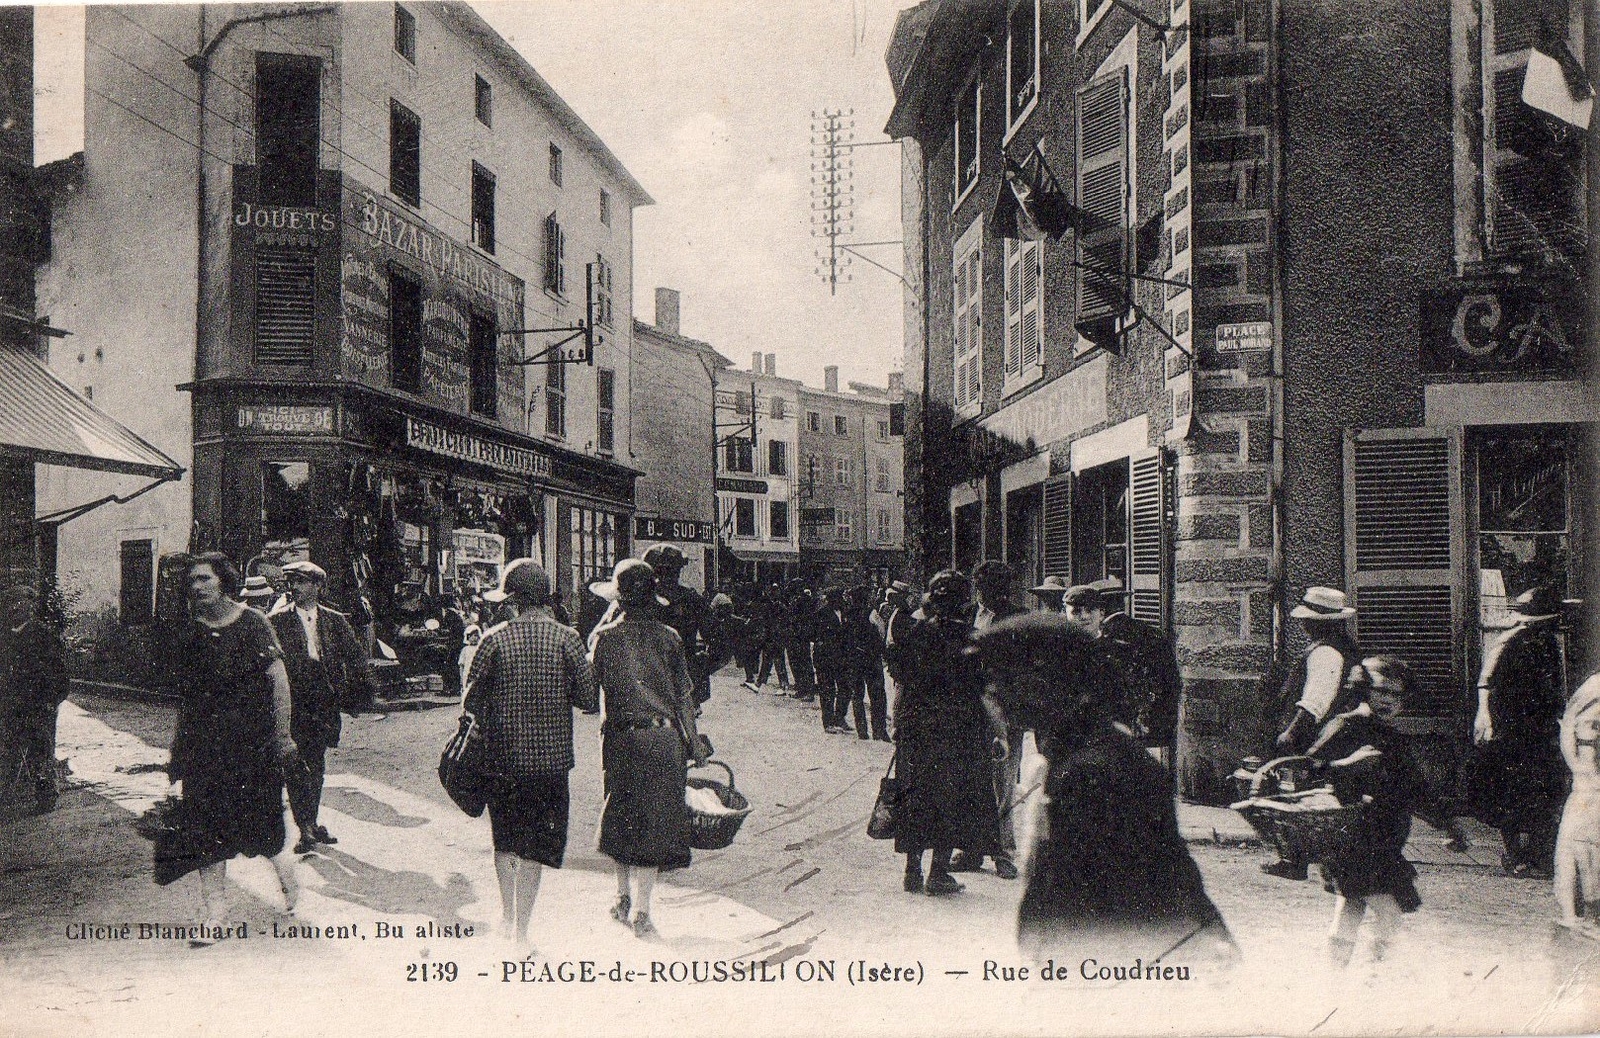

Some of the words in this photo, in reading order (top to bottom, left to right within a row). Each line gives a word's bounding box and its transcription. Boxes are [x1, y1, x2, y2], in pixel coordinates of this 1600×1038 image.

[235, 202, 335, 231] JOUETS
[362, 193, 436, 274] BAZAR
[1223, 325, 1265, 338] PLACE
[238, 409, 253, 428] ON
[258, 412, 310, 424] TROUVE
[314, 410, 333, 430] DE
